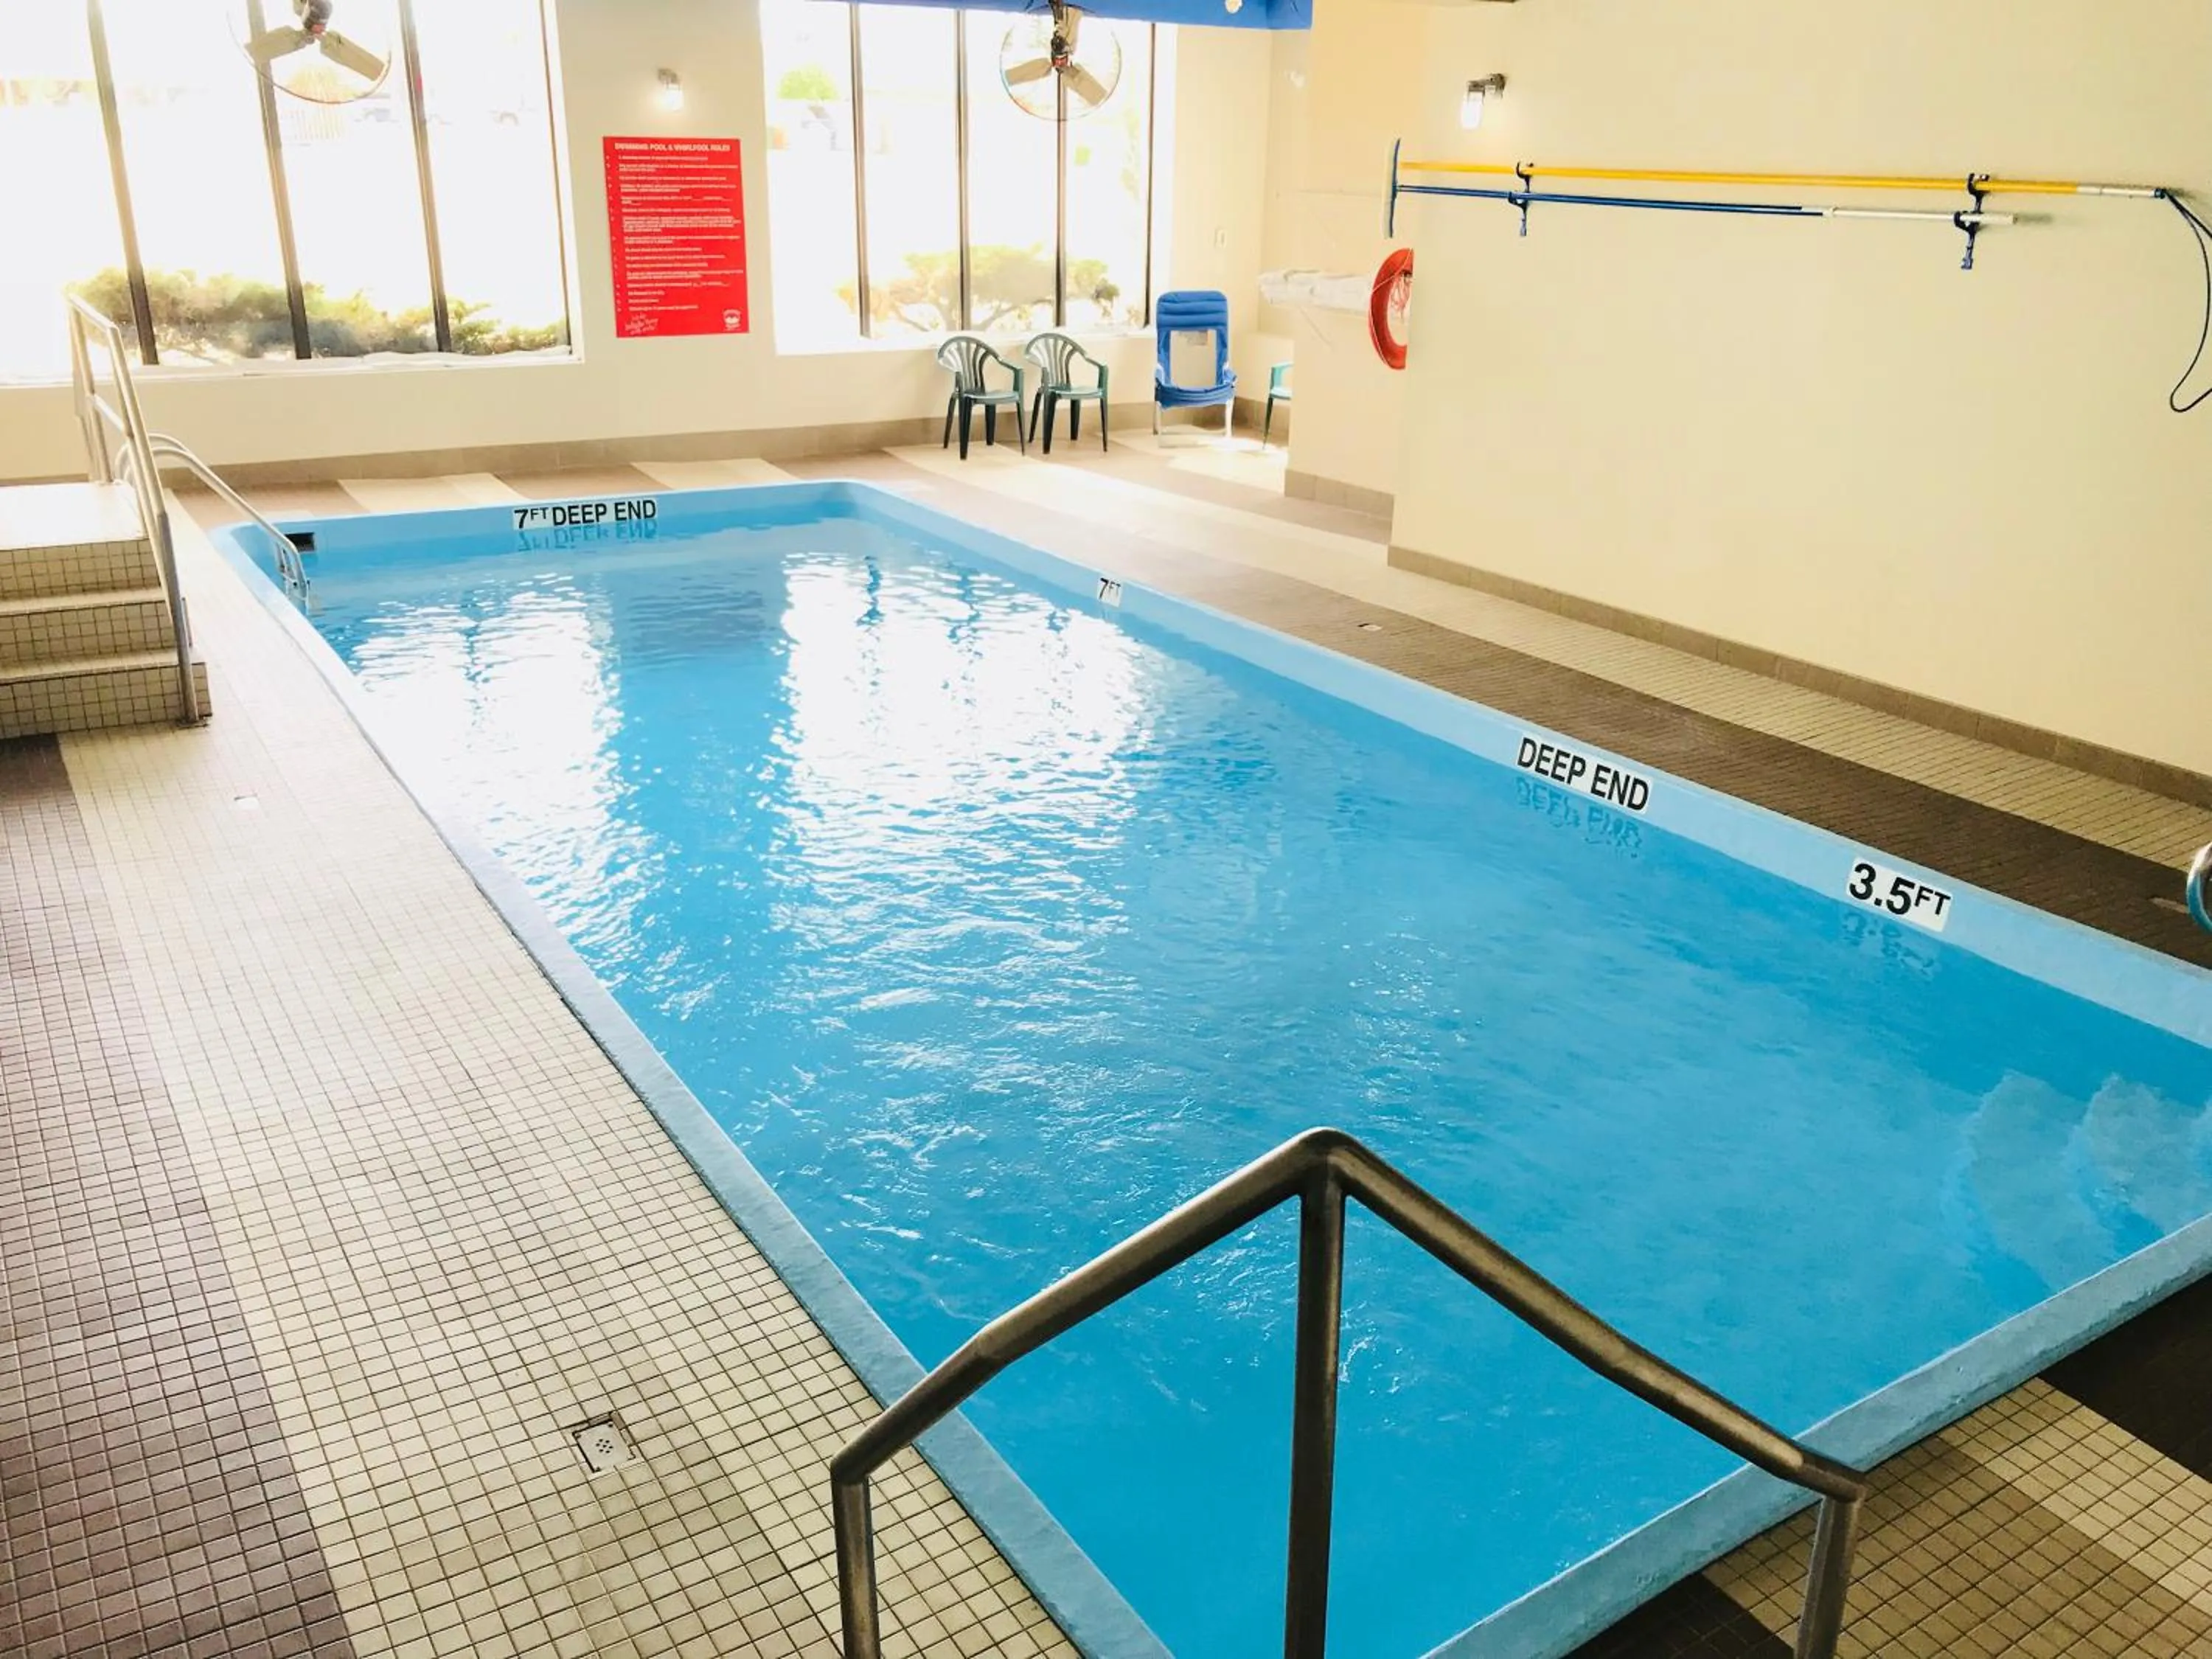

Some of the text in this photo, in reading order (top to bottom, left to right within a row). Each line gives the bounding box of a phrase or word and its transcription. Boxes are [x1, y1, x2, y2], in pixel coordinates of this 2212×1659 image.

[650, 143, 667, 151] POOL
[552, 503, 607, 526] DEEP
[613, 499, 657, 521] END
[1517, 737, 1649, 811] DEEP END
[1849, 863, 1952, 915] 3.5FT
